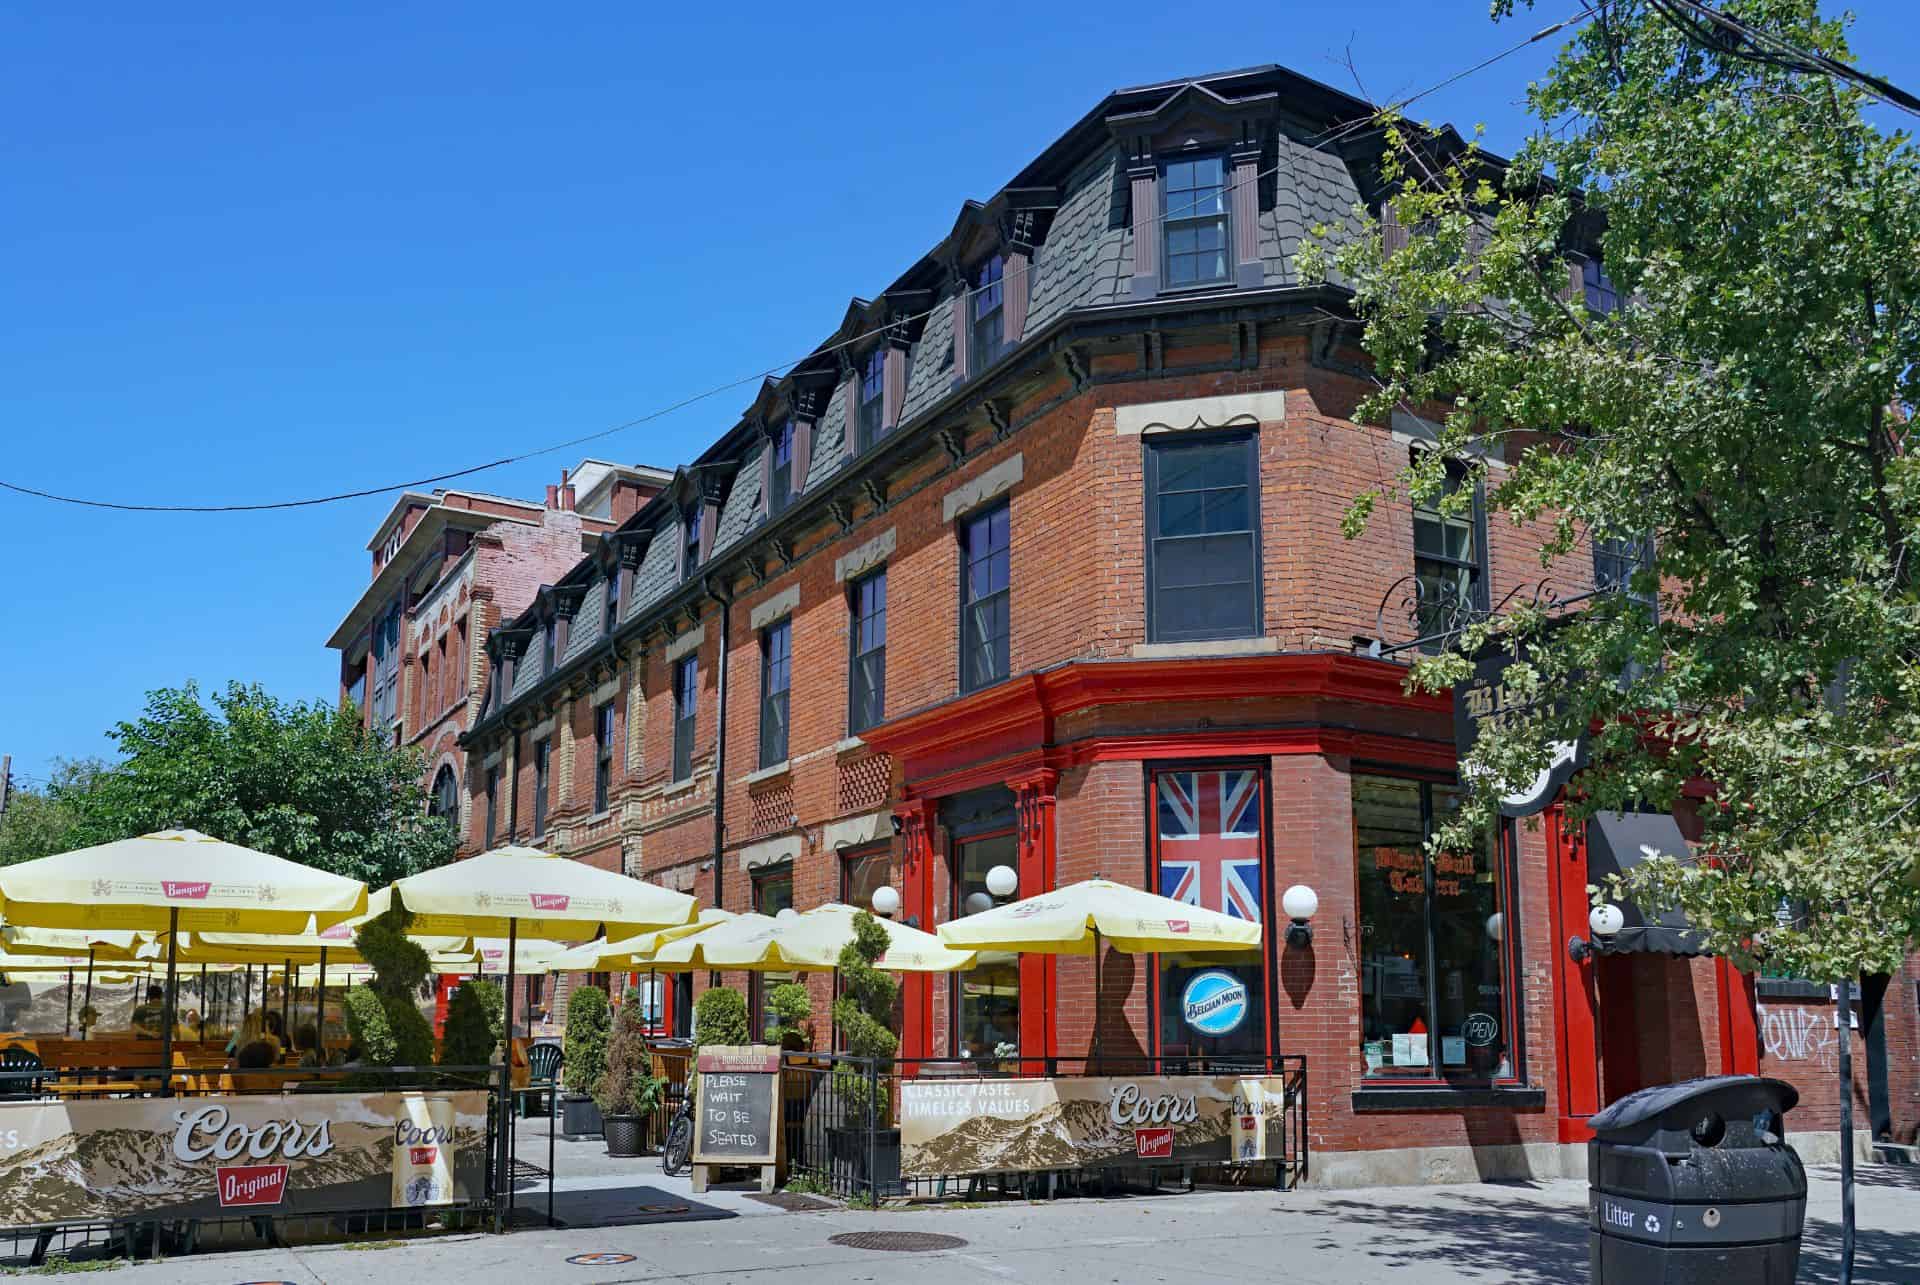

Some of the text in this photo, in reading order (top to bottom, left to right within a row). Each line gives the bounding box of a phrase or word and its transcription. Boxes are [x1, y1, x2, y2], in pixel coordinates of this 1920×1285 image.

[1187, 991, 1242, 1018] BELGIAN MOON
[705, 1074, 747, 1088] PLEASE
[906, 1082, 1016, 1098] CLASSIC TASTE.
[710, 1092, 744, 1103] WAIT
[907, 1099, 1036, 1117] TIMELESS VALUES.
[1110, 1082, 1199, 1126] Coors
[1232, 1095, 1264, 1116] Coors
[705, 1108, 753, 1124] TO BE
[173, 1094, 336, 1163] Coors
[395, 1118, 454, 1146] Coors
[708, 1129, 757, 1146] SEATED
[1140, 1130, 1172, 1154] Original
[224, 1168, 283, 1201] Original
[1605, 1201, 1636, 1228] Litter
